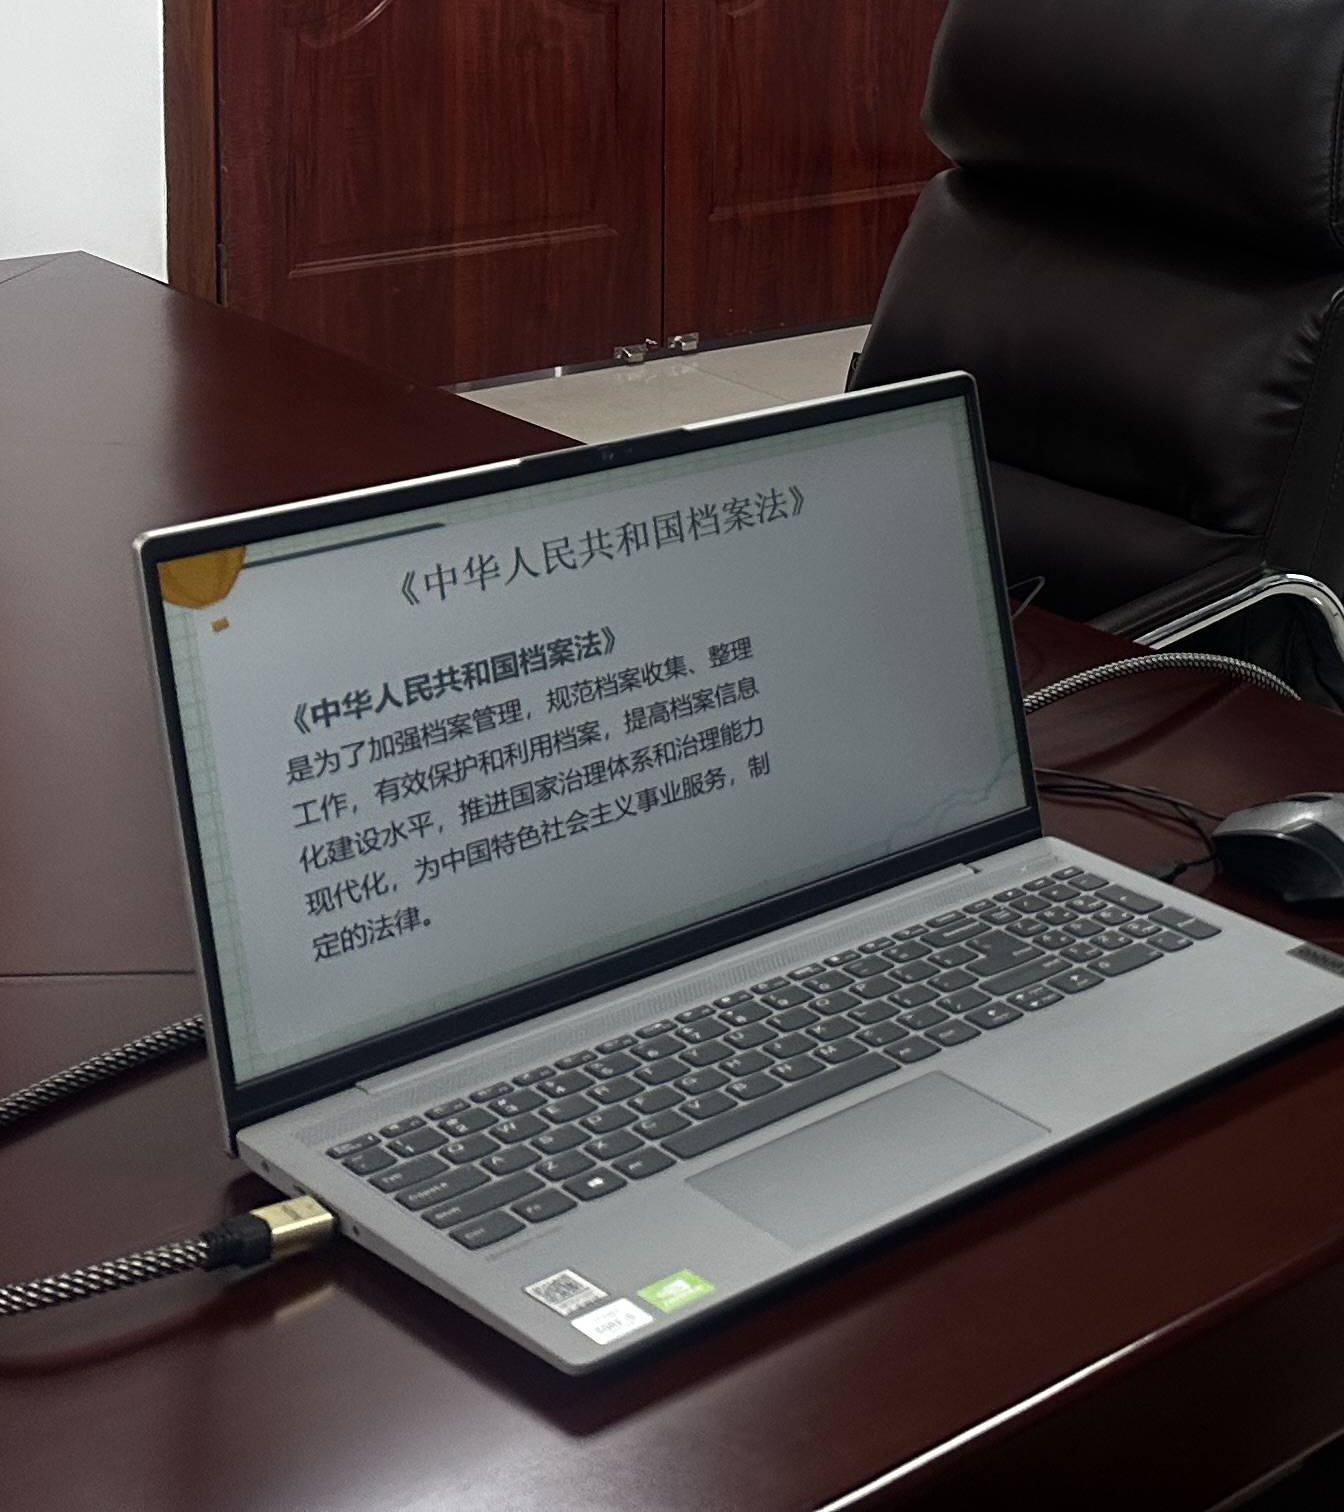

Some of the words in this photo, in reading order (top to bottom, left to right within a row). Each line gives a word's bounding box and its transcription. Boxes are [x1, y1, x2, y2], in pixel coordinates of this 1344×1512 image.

[401, 485, 805, 608] 《中华人民共和国档案法》
[286, 635, 753, 785] 是为了加强档案管理，规范档案收集、整理
[292, 677, 760, 829] 工作，有效保护和利用档案，提高档案信息
[293, 625, 616, 737] 《中华人民共和国档案法》
[298, 715, 765, 874] 化建设水平，推进国家治理体系和治理能力
[305, 754, 770, 916] 现代化，为中国特色社会主义事业服务，制
[312, 907, 434, 962] 定的法律。
